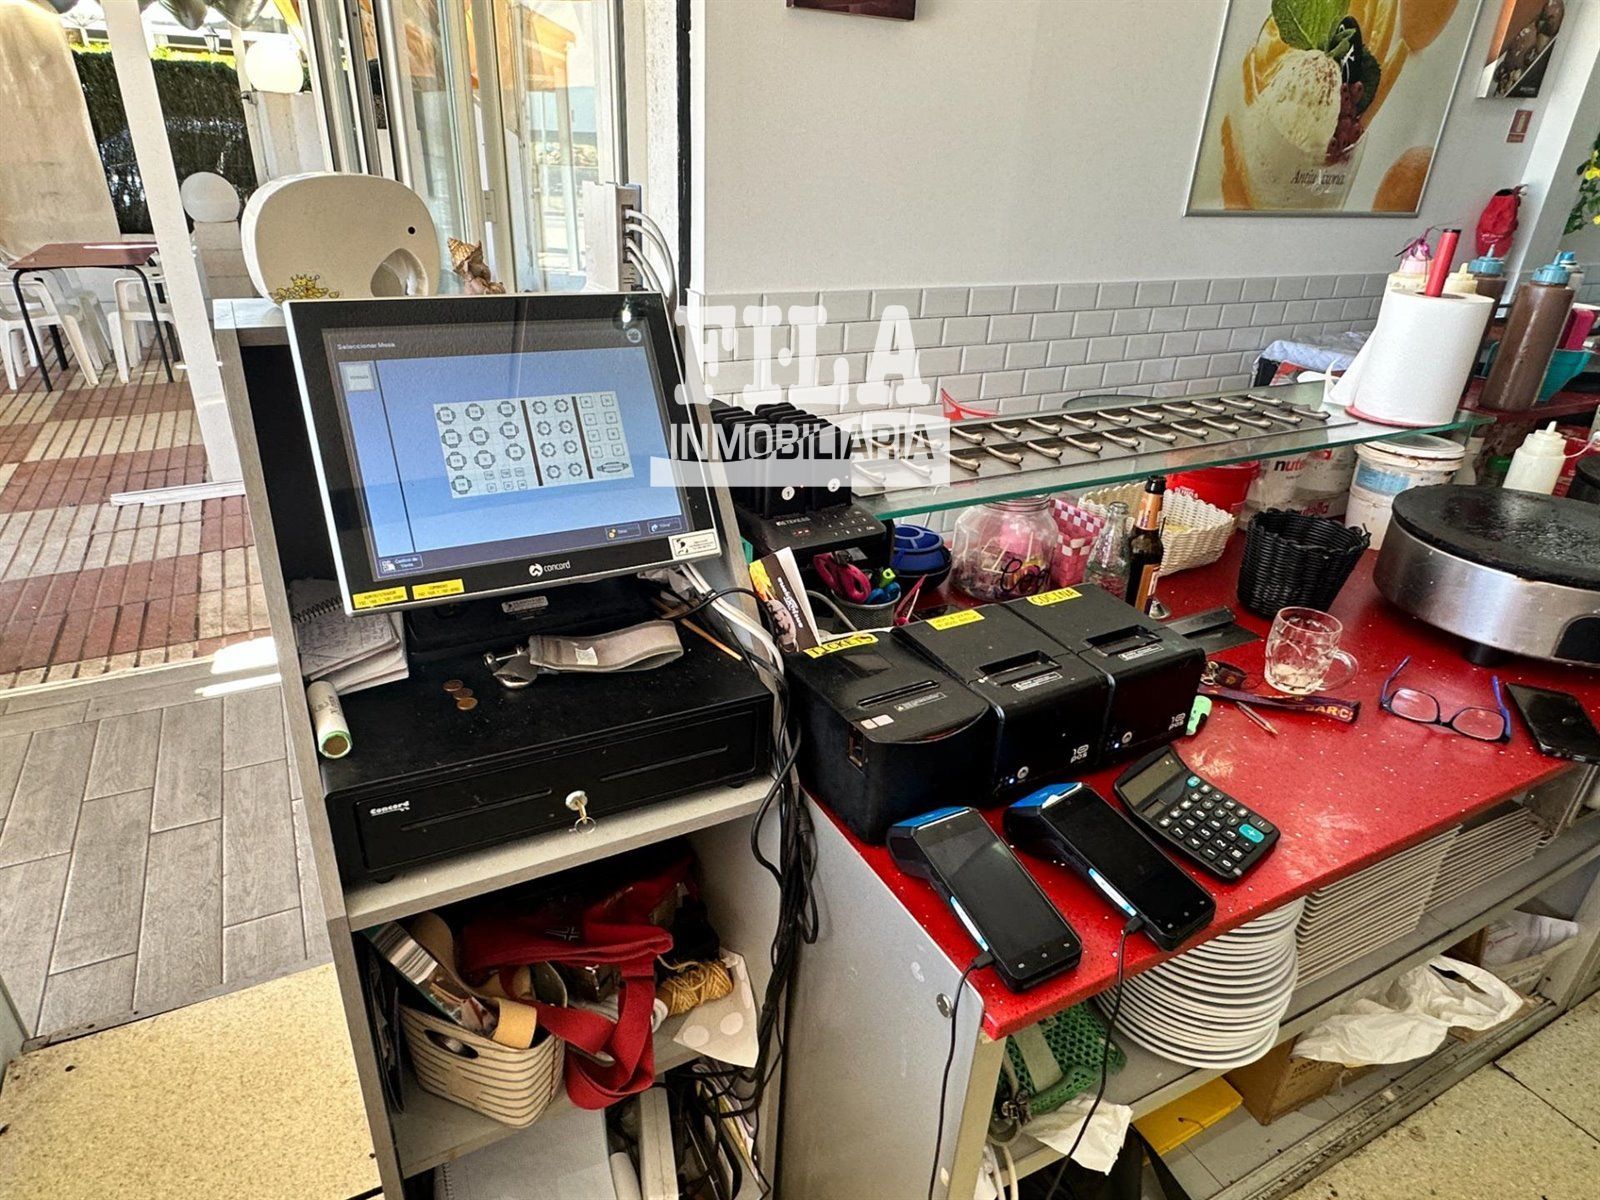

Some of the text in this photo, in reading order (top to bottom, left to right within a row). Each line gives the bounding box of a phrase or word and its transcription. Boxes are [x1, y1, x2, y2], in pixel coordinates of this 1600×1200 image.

[1301, 501, 1329, 516] utella
[543, 560, 571, 572] concord
[1030, 589, 1077, 604] COCINA
[809, 635, 873, 655] TICKETS
[1174, 827, 1184, 835] 7
[1191, 837, 1201, 845] 4
[1201, 828, 1211, 836] 5
[1216, 839, 1227, 847] 2
[1226, 830, 1236, 838] 3
[1222, 859, 1232, 867] 0
